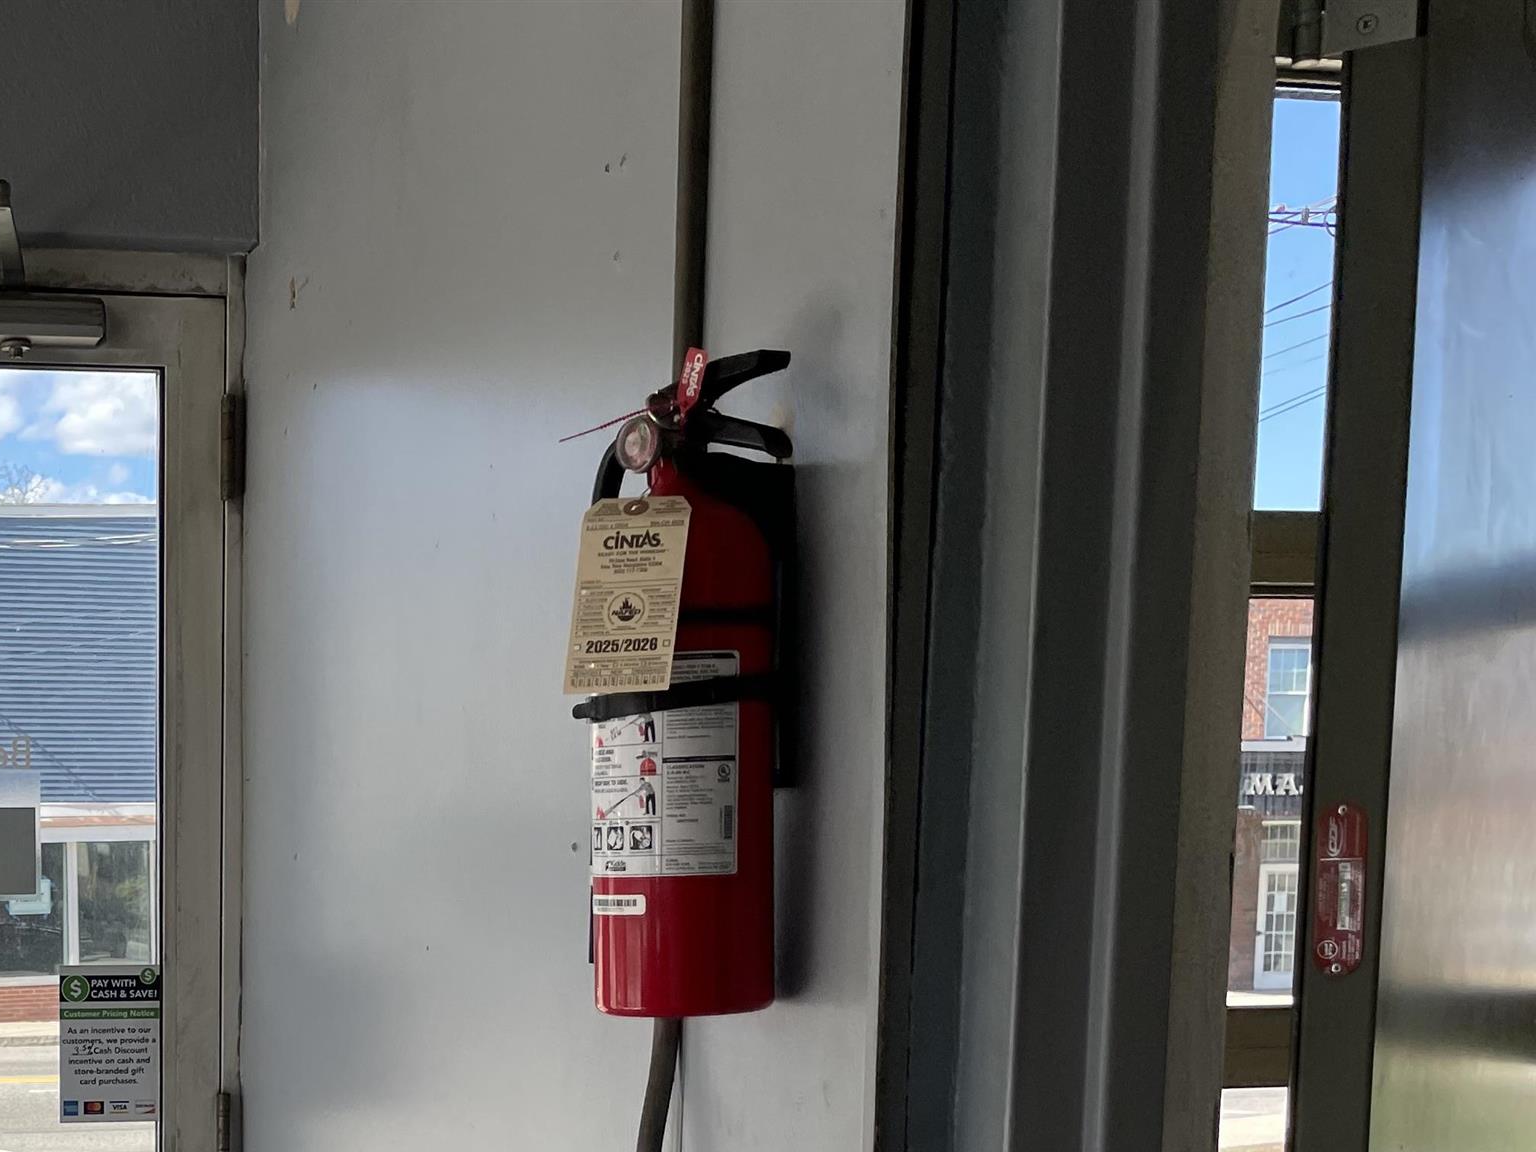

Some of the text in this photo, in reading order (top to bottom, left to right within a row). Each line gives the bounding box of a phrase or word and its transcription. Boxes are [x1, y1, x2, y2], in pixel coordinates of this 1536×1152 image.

[585, 637, 658, 654] 2025/2026
[90, 979, 136, 988] PAY WITH
[90, 990, 158, 998] CASH & SAVE!
[64, 1010, 155, 1018] Customer Pricing Notice
[67, 1026, 78, 1034] As
[90, 1026, 126, 1034] incentive
[128, 1026, 136, 1034] to
[62, 1038, 105, 1046] customers,
[120, 1036, 149, 1046] provide
[94, 1046, 148, 1054] Cash Discount
[136, 1056, 151, 1064] and
[74, 1066, 145, 1076] store-branded gift
[80, 1077, 138, 1086] card purchases.
